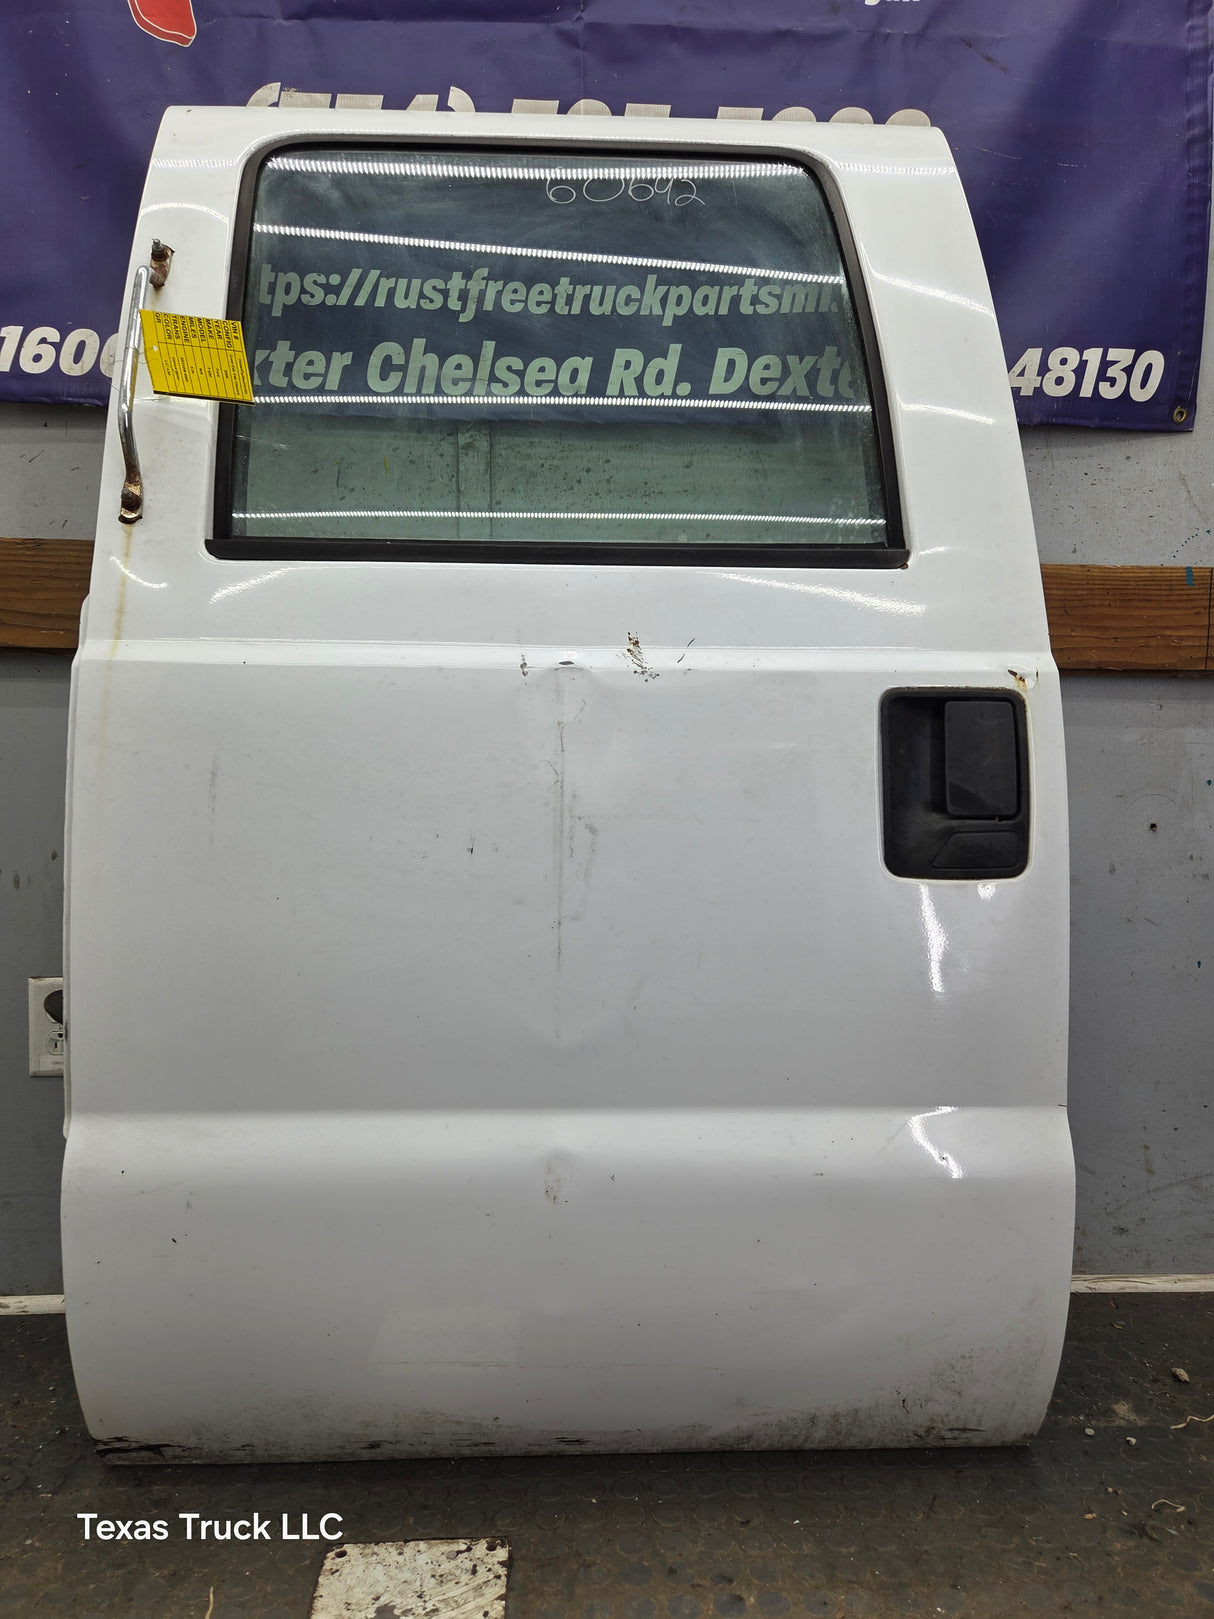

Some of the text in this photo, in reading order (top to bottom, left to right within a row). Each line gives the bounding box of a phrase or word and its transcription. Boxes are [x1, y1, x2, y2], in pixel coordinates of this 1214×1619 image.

[163, 313, 172, 340] COLOR
[171, 314, 180, 340] TRANS
[180, 315, 189, 342] ENGINE
[188, 316, 197, 339] MILES
[197, 317, 206, 342] MODEL
[206, 318, 214, 340] MAKE
[214, 319, 222, 340] YEAR
[223, 320, 233, 349] CONFIG
[366, 338, 593, 396] Chelsea
[605, 343, 692, 396] Rd.
[1008, 347, 1165, 402] 48130
